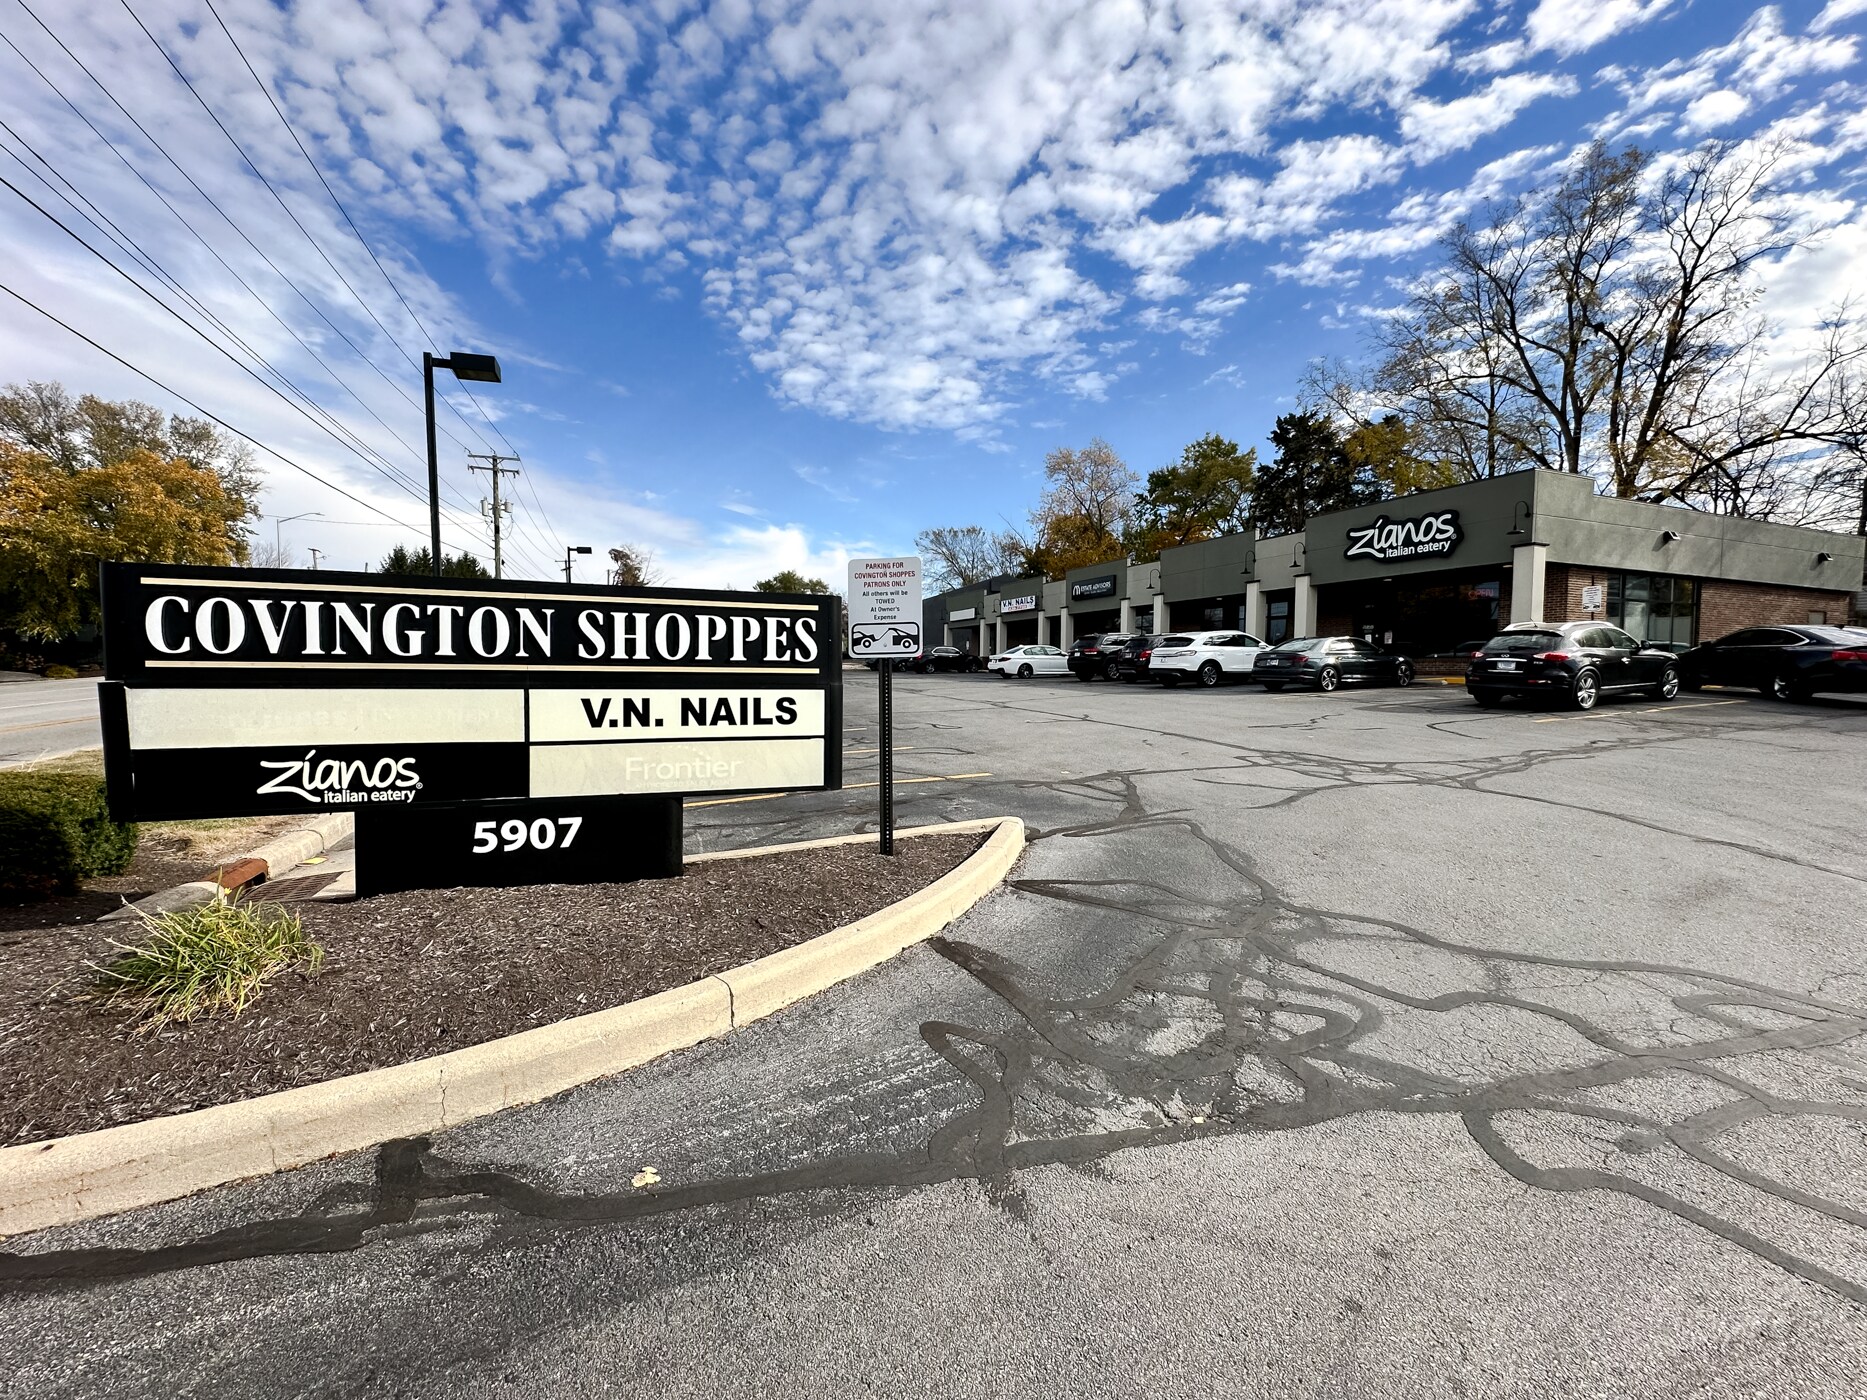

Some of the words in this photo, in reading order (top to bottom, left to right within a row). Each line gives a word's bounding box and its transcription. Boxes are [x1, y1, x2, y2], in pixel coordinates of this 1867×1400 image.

[1386, 546, 1415, 558] italian
[1417, 541, 1451, 552] eatery
[1015, 596, 1034, 605] NAILS
[145, 596, 555, 657] COVINGTON
[578, 610, 819, 662] SHOPPES
[581, 698, 664, 728] V.N.
[681, 697, 798, 726] NAILS
[626, 757, 742, 780] Frontier
[324, 789, 368, 803] italian
[370, 789, 416, 803] eatery
[473, 817, 583, 853] 5907
